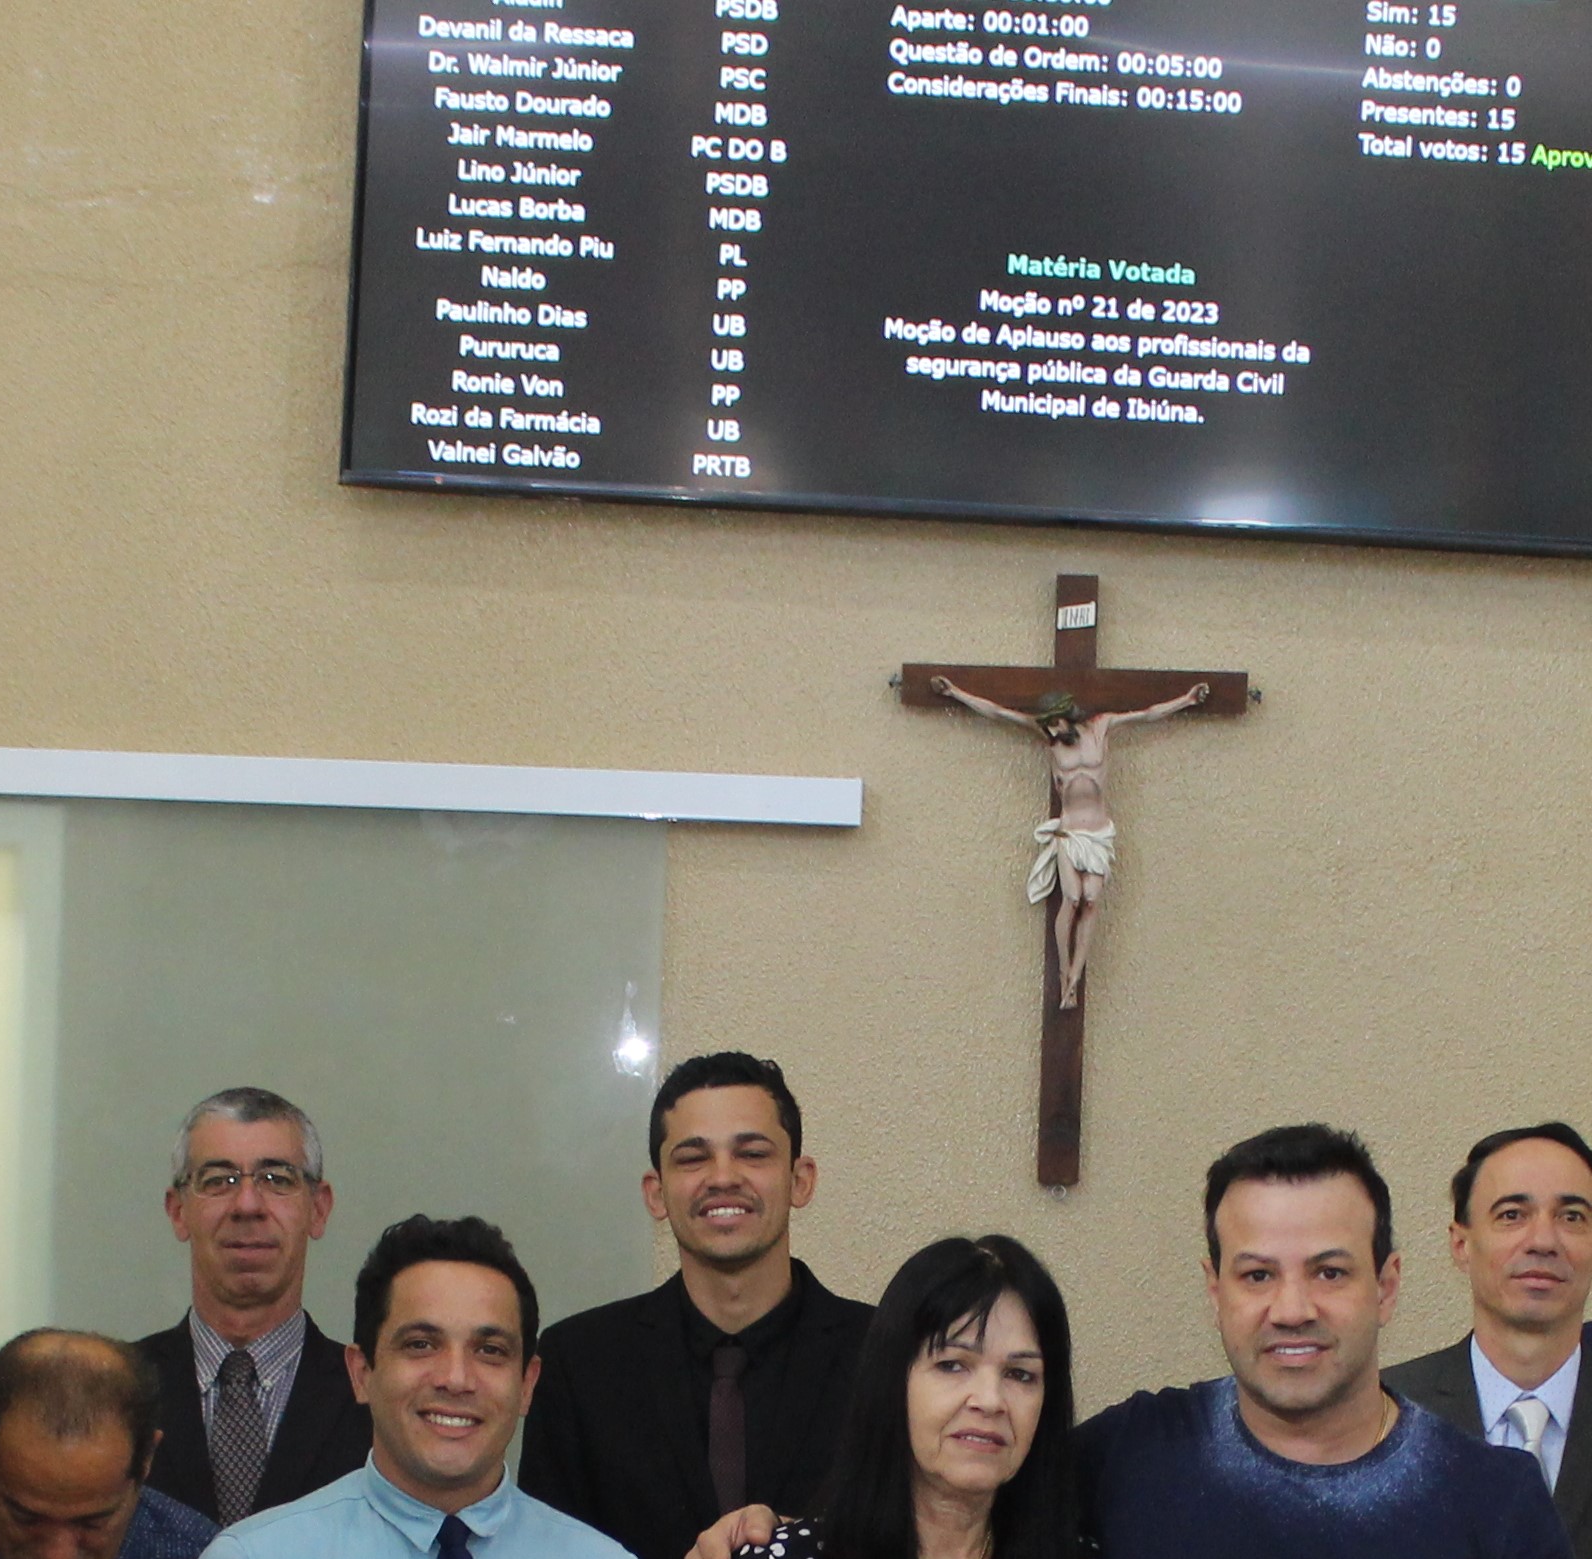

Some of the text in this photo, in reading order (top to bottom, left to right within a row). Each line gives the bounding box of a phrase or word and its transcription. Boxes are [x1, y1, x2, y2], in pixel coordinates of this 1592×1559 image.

[715, 0, 779, 22] PSDB
[890, 4, 1090, 37] Aparte: 00:01:00
[1365, 0, 1457, 28] Sim: 15
[418, 15, 636, 49] Devanil da Ressaca
[720, 30, 769, 57] PSD
[1364, 33, 1442, 60] Não: 0
[427, 50, 623, 83] Dr. Walmir Júnior
[889, 37, 1223, 80] Questão de Ordem: 00:05:00
[719, 65, 767, 92] PSC
[887, 70, 1243, 115] Considerações Finais: 00:15:00
[1361, 66, 1522, 99] Abstenções: 0
[434, 85, 612, 119] Fausto Dourado
[714, 101, 768, 127] MDB
[1359, 99, 1516, 131] Presentes: 15
[447, 121, 594, 152] Jair Marmelo
[691, 134, 788, 163] PC DO B
[1357, 131, 1413, 158] Total
[1418, 139, 1488, 163] votos:
[1497, 141, 1526, 165] 15
[457, 158, 582, 187] Lino Júnior
[705, 171, 769, 198] PSDB
[448, 192, 586, 223] Lucas Borba
[708, 206, 762, 233] MDB
[416, 226, 615, 260] Luiz Fernando Piu
[719, 242, 748, 267] PL
[480, 264, 547, 291] Naldo
[1007, 253, 1196, 285] Matéria Votada
[716, 277, 747, 301] PP
[435, 297, 588, 329] Paulinho Dias
[979, 289, 1220, 325] Moção nº 21 de 2023
[712, 313, 747, 338] UB
[883, 316, 1311, 364] Moção de Aplauso aos profissionais da
[459, 334, 560, 362] Pururuca
[710, 348, 745, 372] UB
[451, 369, 564, 398] Ronie Von
[905, 355, 1285, 395] segurança pública da Guarda Civil
[710, 383, 741, 407] PP
[980, 389, 1205, 424] Municipal de Ibiúna.
[410, 401, 601, 435] Rozi da Farmácia
[706, 418, 741, 443] UB
[427, 439, 581, 469] Valnei Galvão
[692, 452, 752, 479] PRTB
